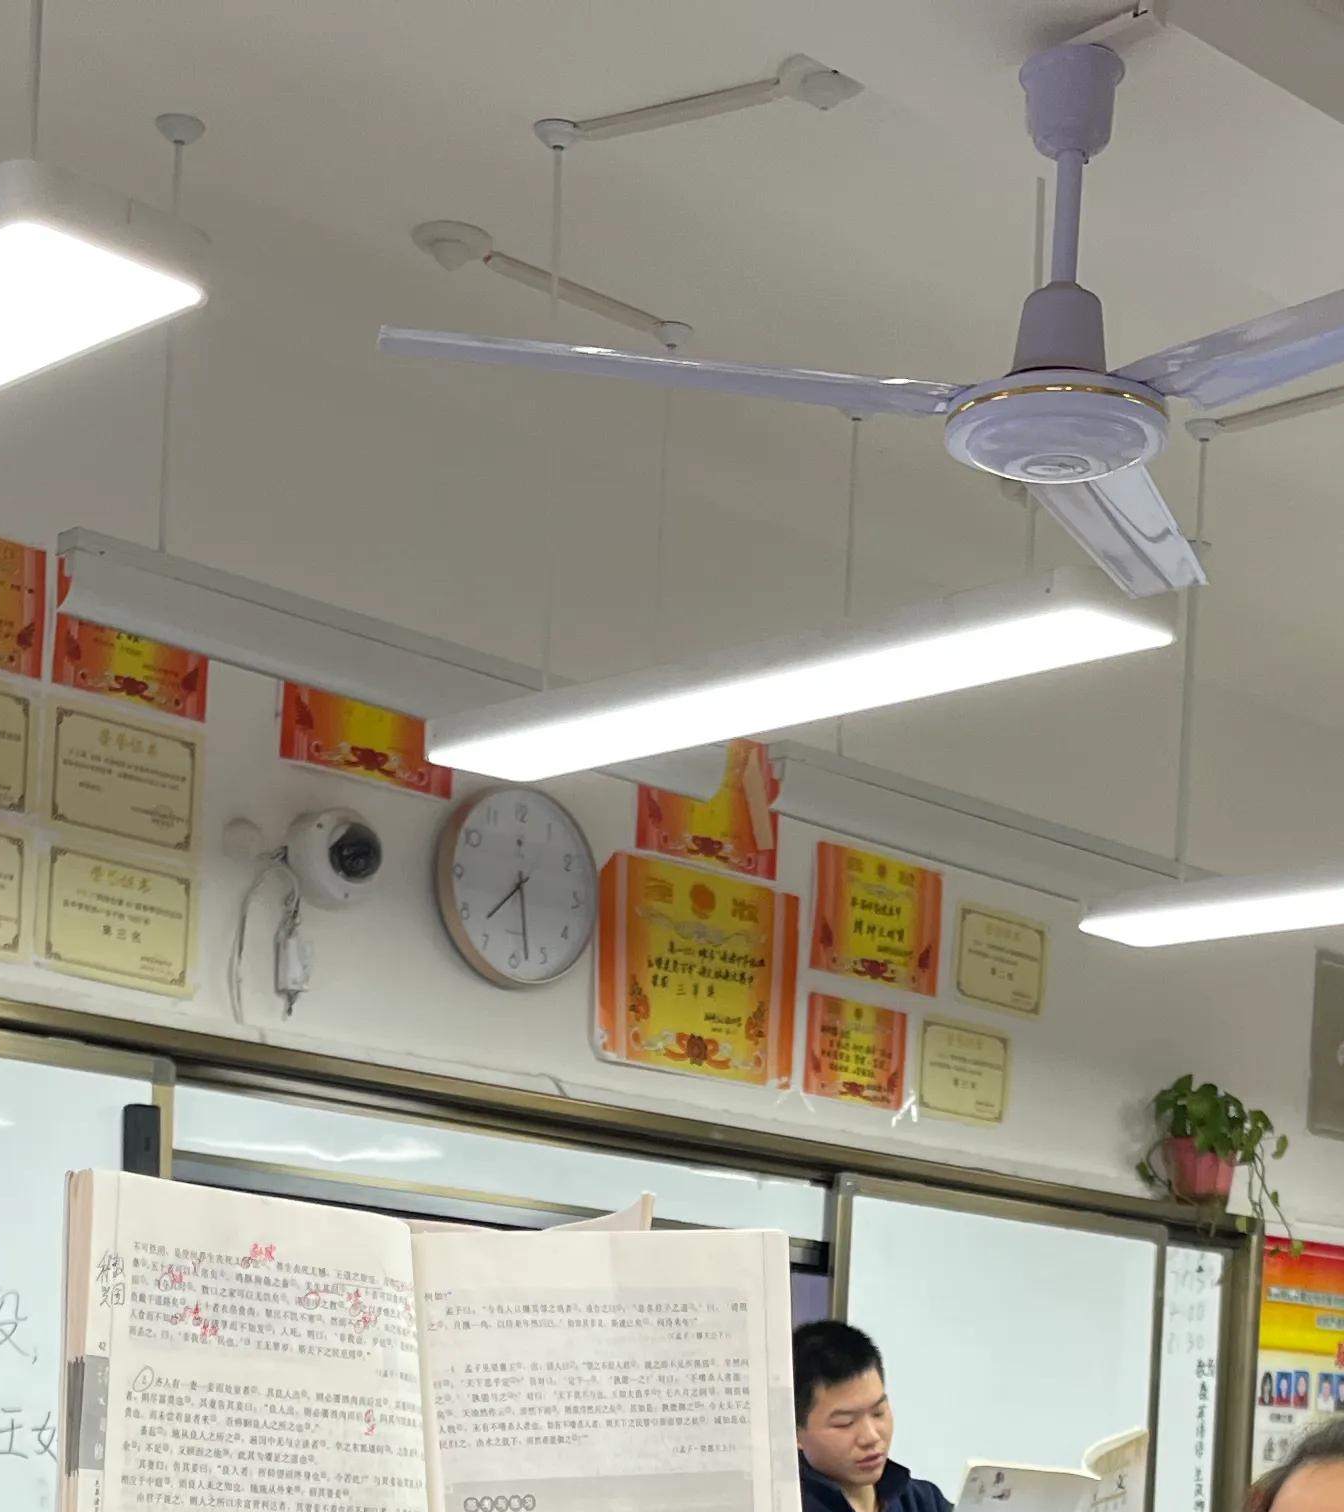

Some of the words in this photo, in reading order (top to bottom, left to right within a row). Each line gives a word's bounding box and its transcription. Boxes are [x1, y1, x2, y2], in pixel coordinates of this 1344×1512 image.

[487, 807, 498, 826] 11
[465, 829, 482, 848] 10
[563, 853, 572, 871] 2
[454, 863, 464, 880] 9
[570, 891, 580, 909] 3
[461, 902, 470, 920] 8
[561, 925, 569, 940] 4
[481, 933, 489, 950] 7
[508, 952, 520, 969] 6
[539, 947, 547, 964] 5
